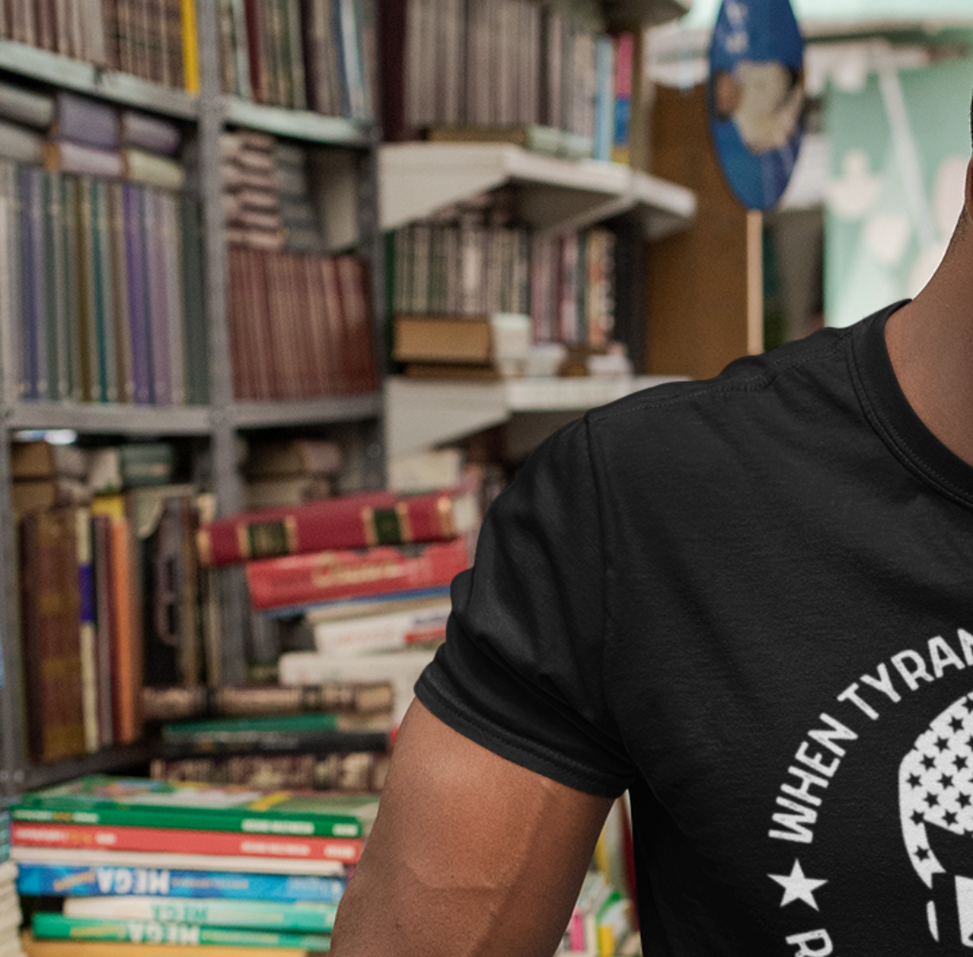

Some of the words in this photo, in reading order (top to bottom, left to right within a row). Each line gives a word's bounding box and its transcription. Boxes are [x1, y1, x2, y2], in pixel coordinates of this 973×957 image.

[769, 713, 859, 844] WHEN
[97, 868, 171, 894] MEGA
[128, 921, 200, 944] MEGA
